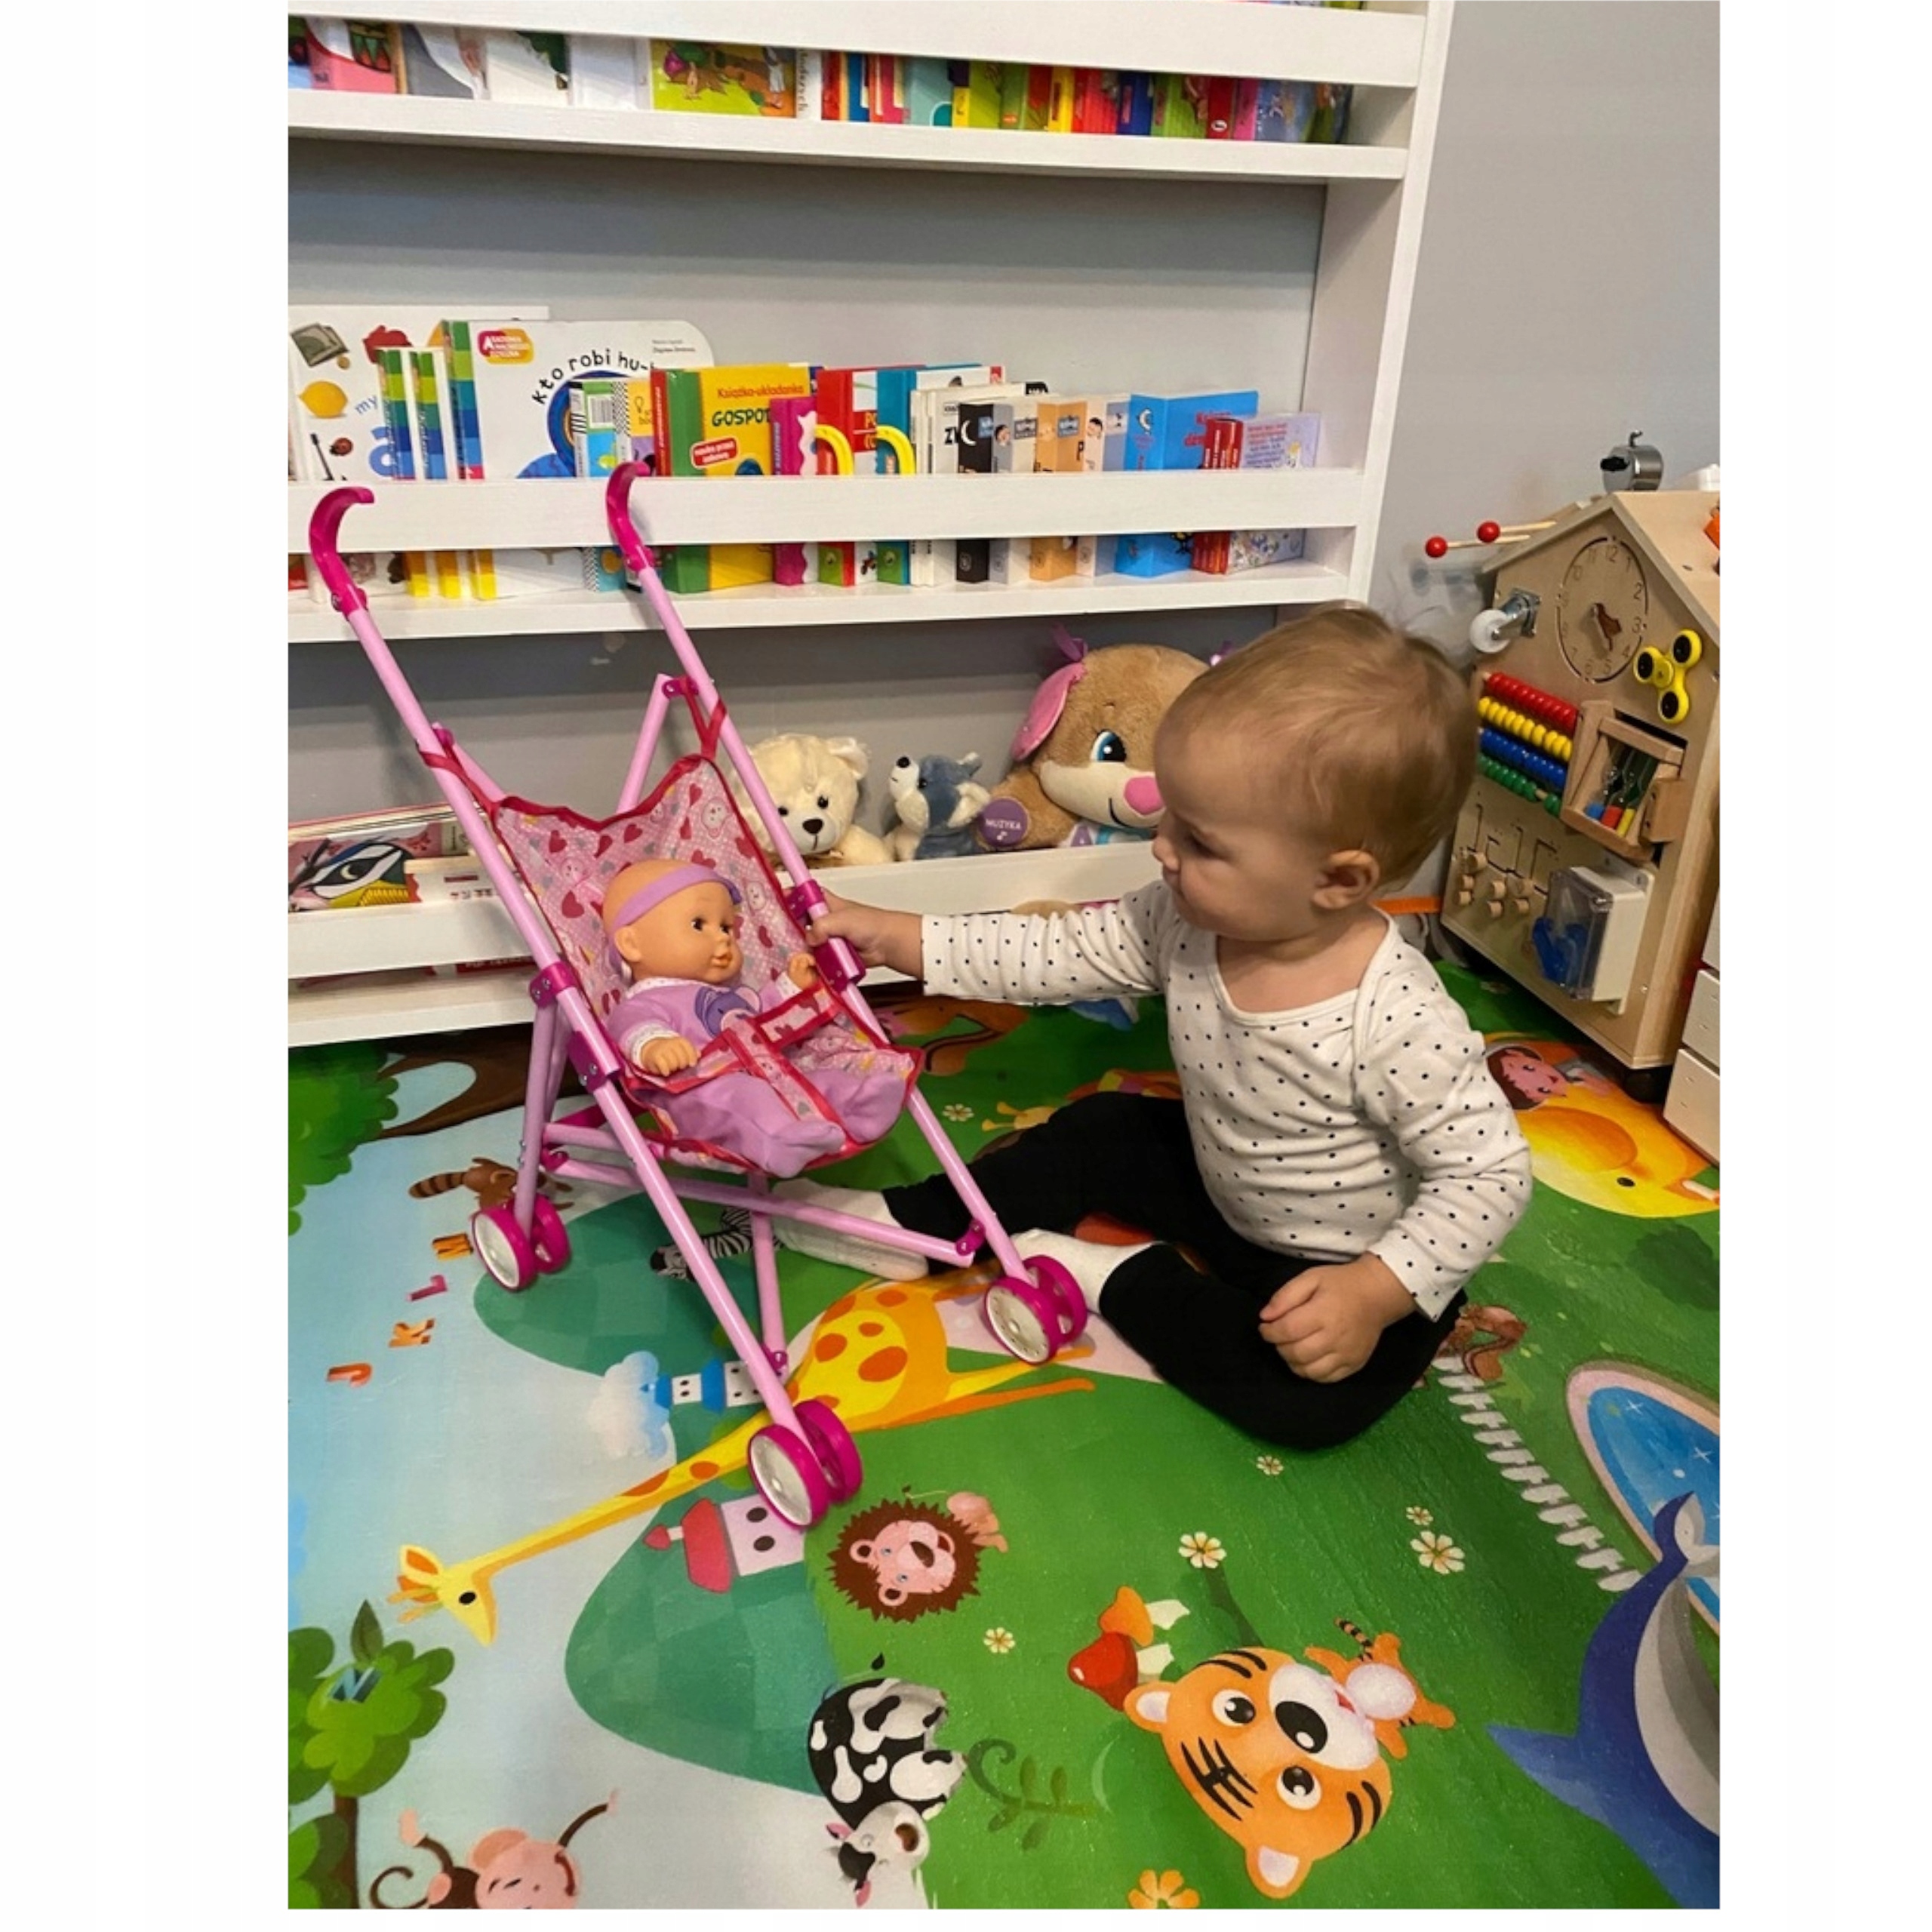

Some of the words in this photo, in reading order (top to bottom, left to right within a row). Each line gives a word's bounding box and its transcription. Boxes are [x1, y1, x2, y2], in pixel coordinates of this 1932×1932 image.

[532, 368, 565, 405] kto
[568, 348, 611, 372] robi
[1605, 545, 1618, 563] 12
[1625, 557, 1632, 572] 1
[1634, 582, 1643, 600] 2
[1632, 616, 1642, 633] 3
[1623, 644, 1631, 659] 4
[985, 818, 1021, 830] MUZYKA
